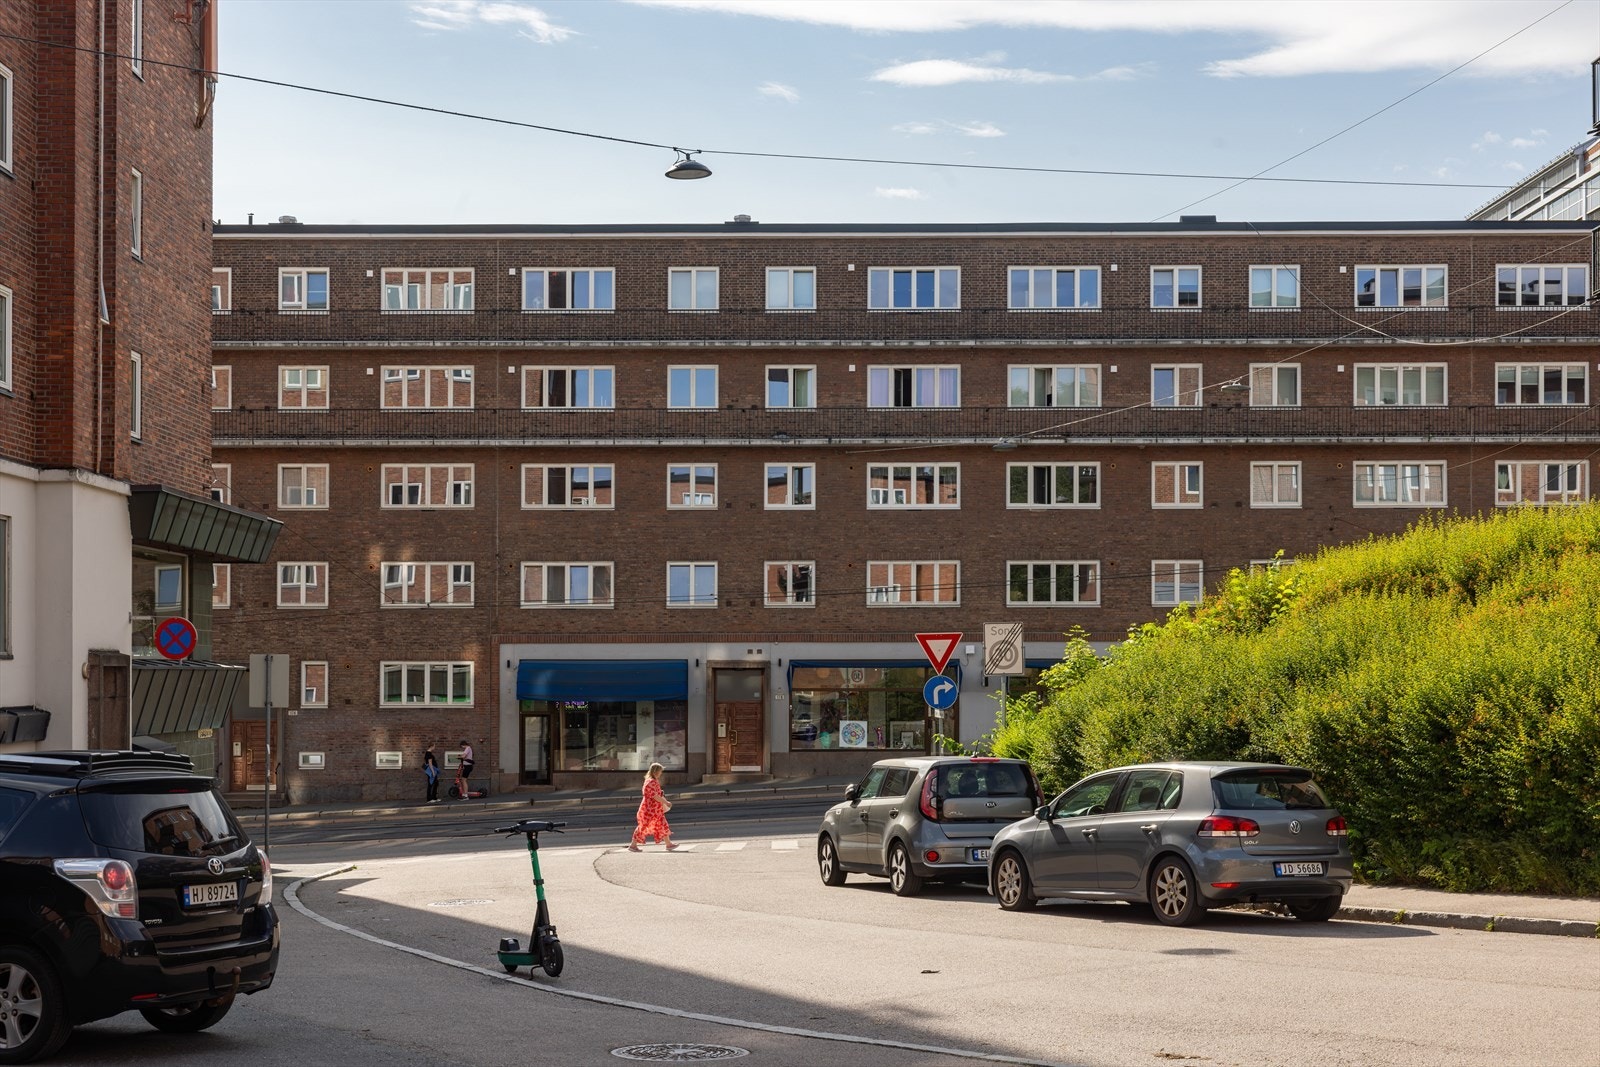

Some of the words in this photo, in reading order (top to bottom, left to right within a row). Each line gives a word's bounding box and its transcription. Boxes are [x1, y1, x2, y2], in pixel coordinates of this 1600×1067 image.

[990, 626, 1016, 636] Son
[1283, 865, 1294, 874] JD
[1297, 863, 1321, 873] 56686
[192, 886, 204, 902] HJ
[207, 884, 235, 900] 89724
